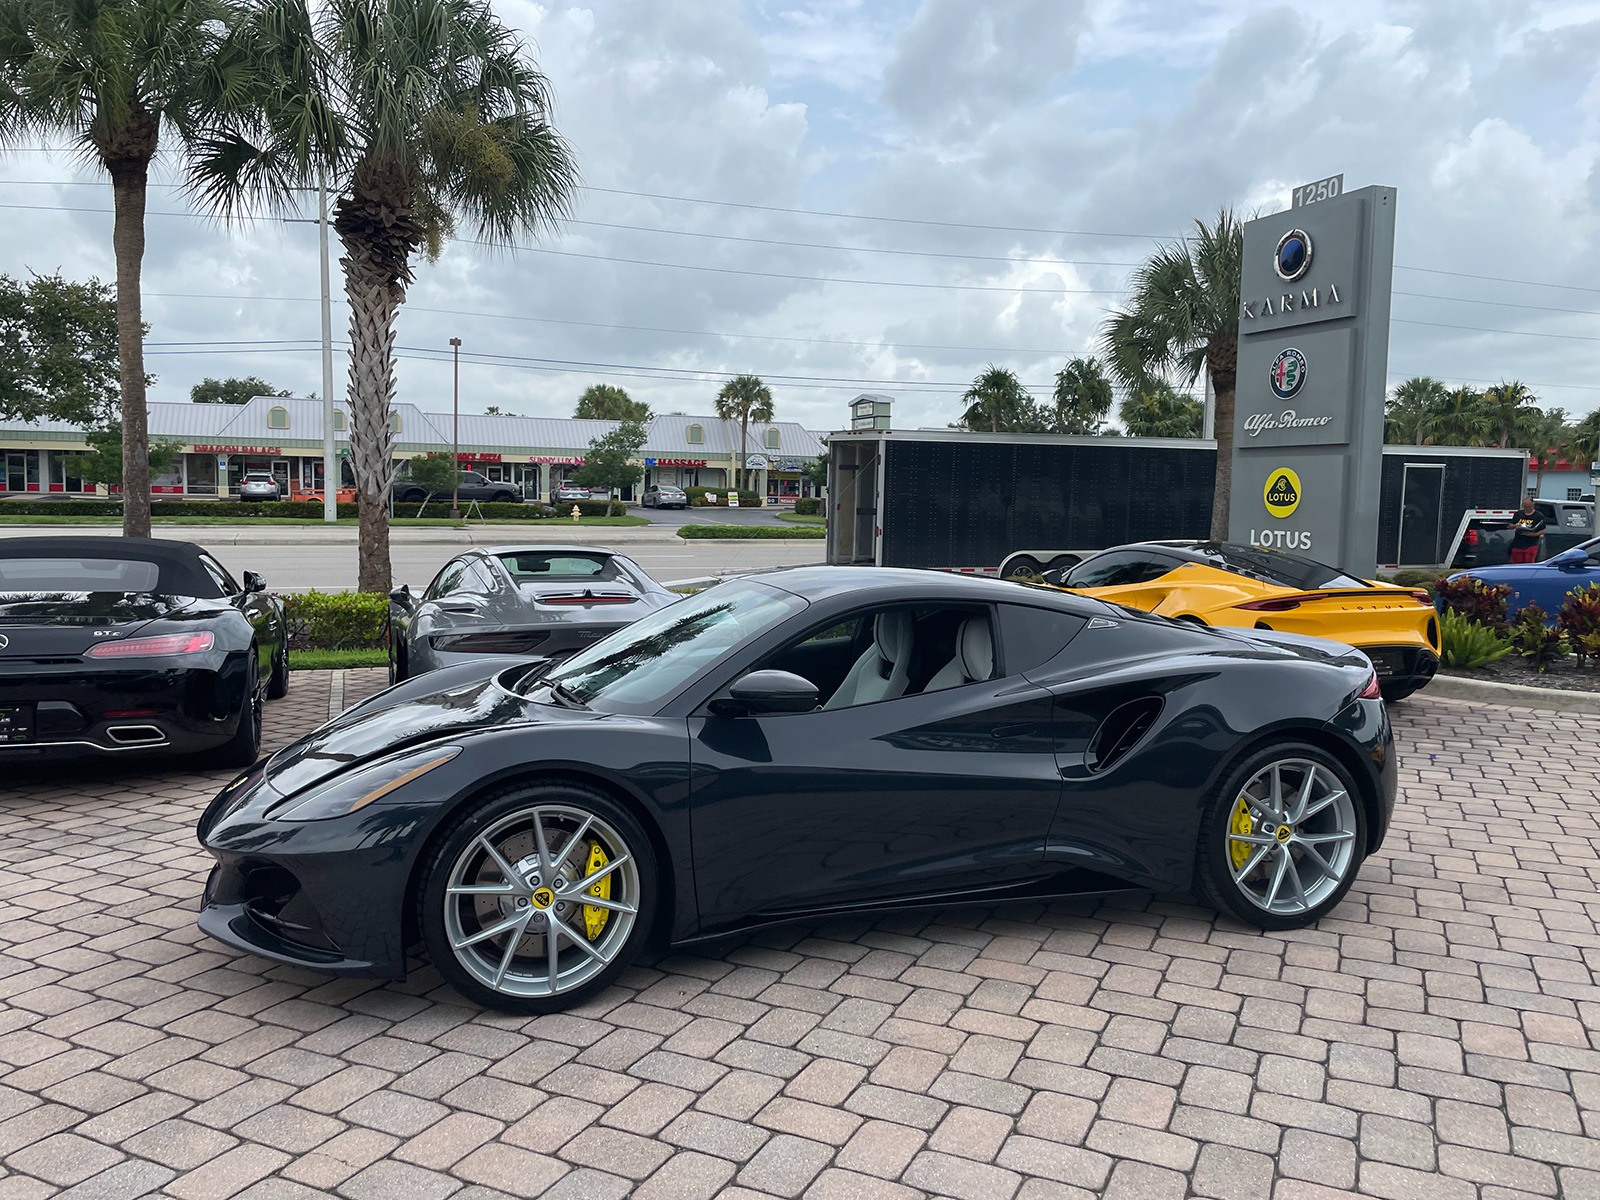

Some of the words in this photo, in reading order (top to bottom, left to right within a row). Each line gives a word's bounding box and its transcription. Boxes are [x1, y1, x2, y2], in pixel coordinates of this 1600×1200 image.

[1296, 177, 1339, 207] 1250
[1243, 284, 1341, 319] KARMA
[1271, 355, 1284, 376] ALFA
[1287, 350, 1306, 373] ROMEO
[1244, 412, 1278, 437] Alfa
[1278, 409, 1333, 429] Romeo
[194, 444, 239, 454] DRAGON
[242, 446, 281, 456] PALACE
[529, 456, 555, 464] SUNNY
[658, 458, 708, 467] MASSAGE
[1268, 493, 1296, 502] LOTUS
[1250, 529, 1312, 550] LOTUS
